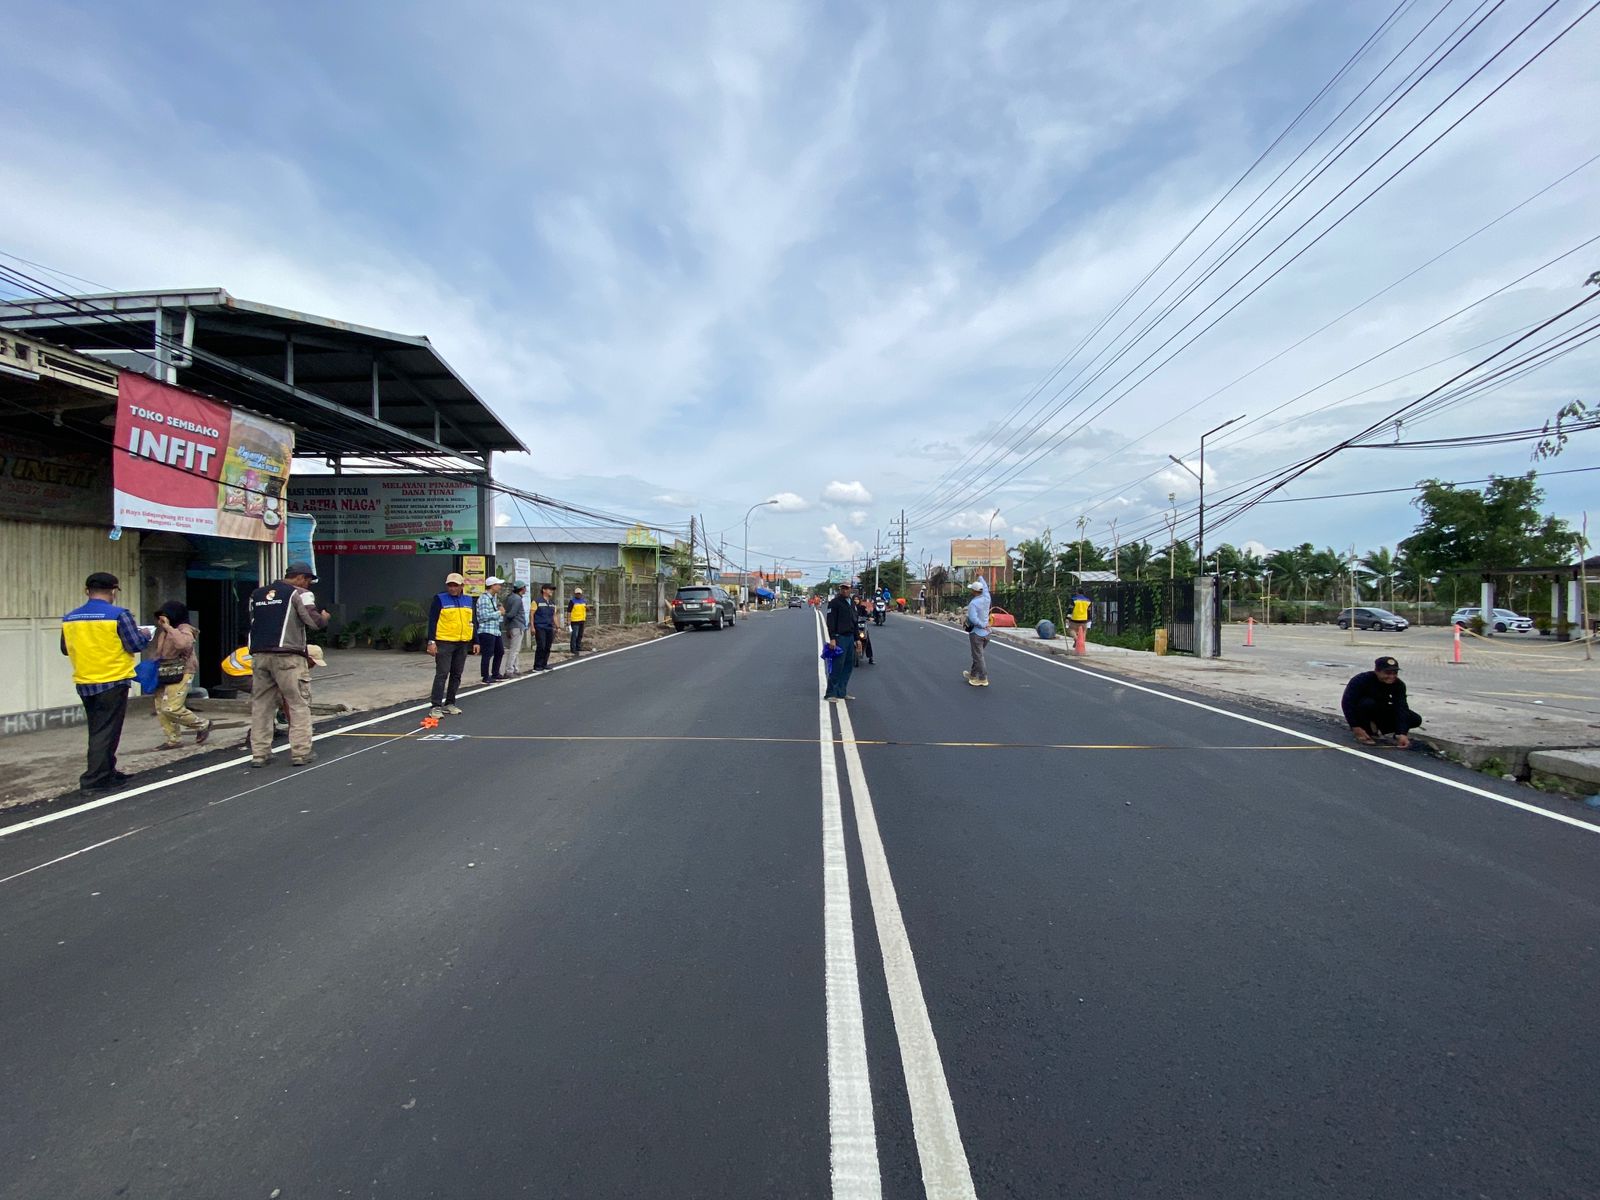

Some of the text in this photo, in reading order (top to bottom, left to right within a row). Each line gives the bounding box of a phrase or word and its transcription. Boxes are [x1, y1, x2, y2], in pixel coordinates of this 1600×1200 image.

[129, 405, 220, 438] TOKO SEMBAKO
[128, 426, 216, 472] INFIT
[305, 487, 336, 496] SIMPAN
[338, 487, 368, 496] PINJAM
[302, 499, 338, 511] ARTHA
